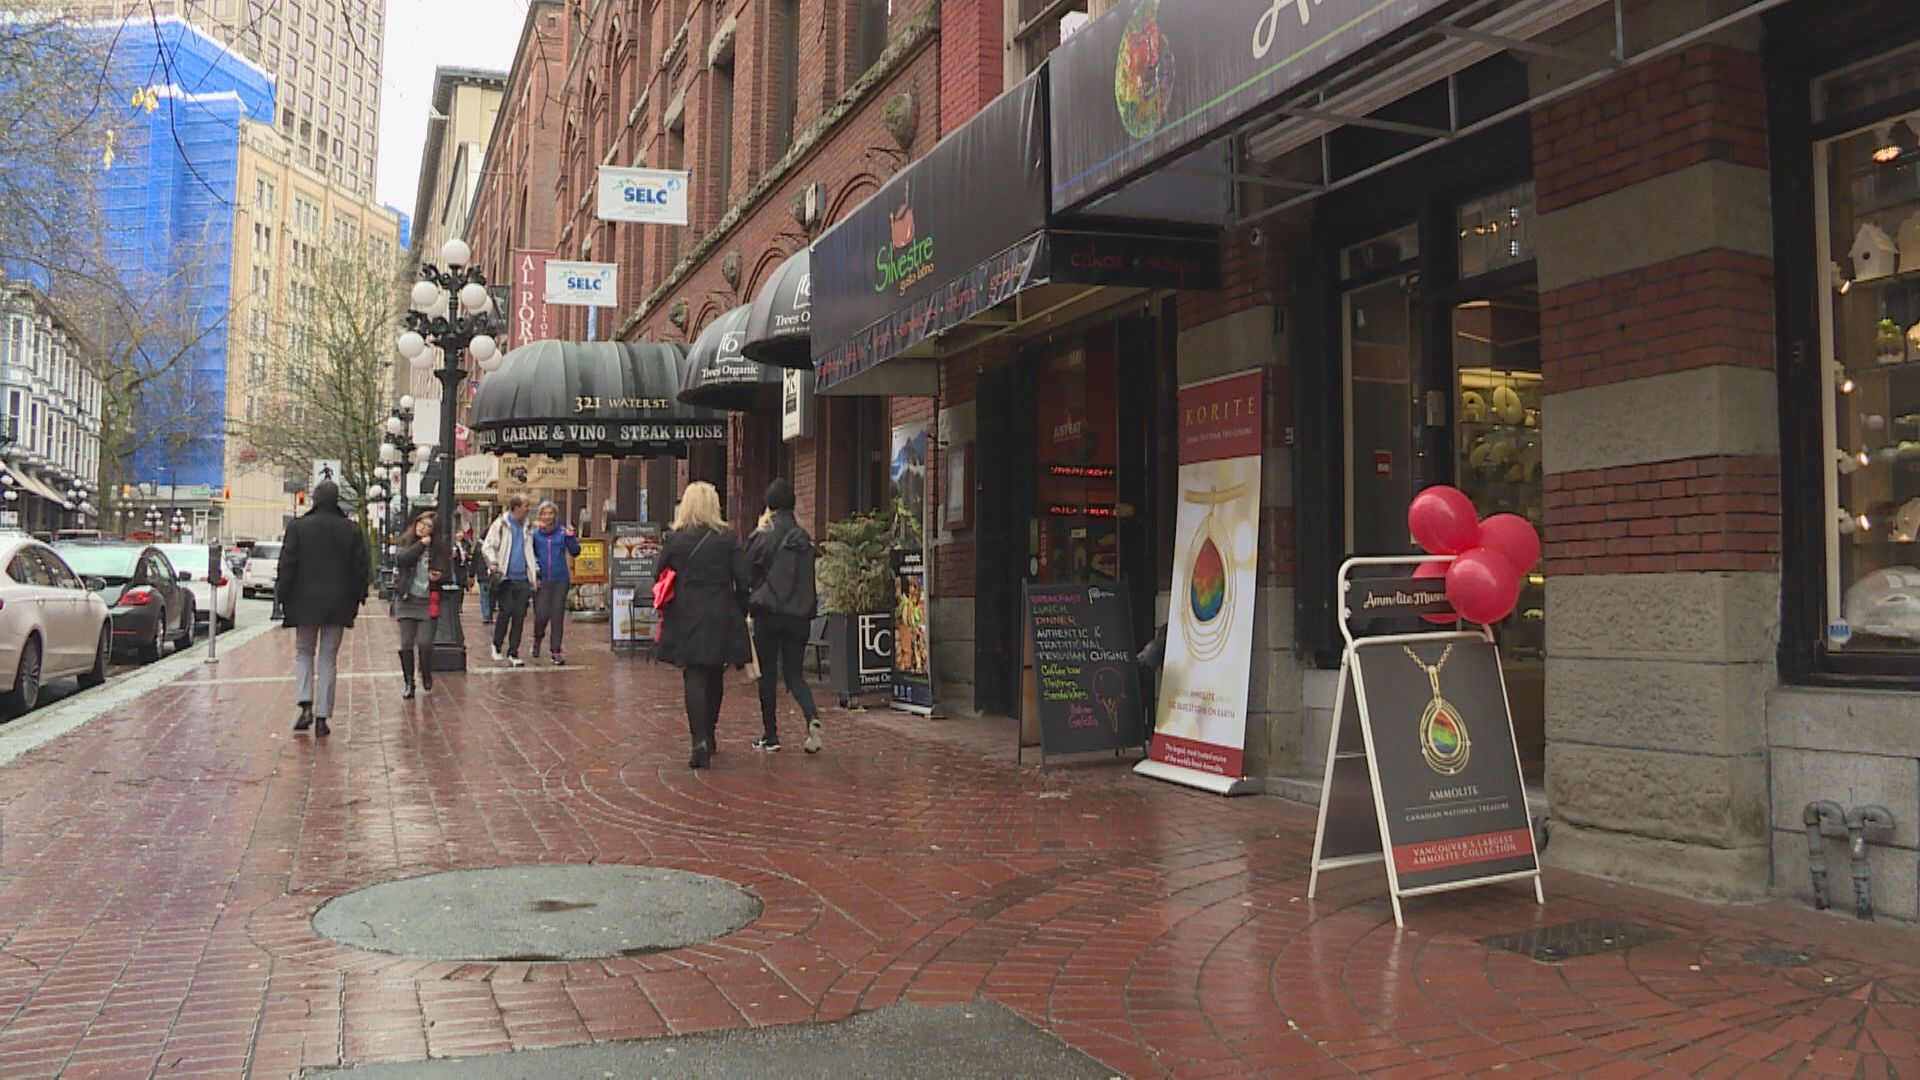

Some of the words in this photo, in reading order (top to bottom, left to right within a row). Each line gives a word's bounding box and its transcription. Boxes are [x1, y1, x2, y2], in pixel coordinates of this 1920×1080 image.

[624, 186, 668, 205] SELC
[874, 236, 934, 293] Silvestre
[567, 277, 602, 290] SELC
[774, 315, 799, 327] Trees
[701, 367, 722, 379] Trees
[721, 364, 759, 379] Organic
[574, 397, 601, 413] 321
[608, 398, 649, 409] WATER
[1185, 396, 1255, 427] KORITE
[502, 424, 549, 442] CARNE
[551, 427, 566, 441] &
[568, 424, 607, 441] VINO
[620, 424, 672, 441] STEAK
[672, 423, 724, 440] HOUSE
[537, 467, 569, 476] HOUSE
[1033, 604, 1067, 615] LUNCH
[1034, 616, 1078, 627] DINNER
[1036, 627, 1089, 639] AUTHENTIC
[1036, 640, 1103, 651] TRADITIONAL
[1036, 650, 1088, 662] PERUVIAN
[1089, 650, 1131, 663] CUISINE
[859, 674, 880, 684] Trees
[1429, 784, 1479, 801] AMMOLITE
[1405, 812, 1443, 823] CANADIAN
[1443, 806, 1477, 818] NATIONAL
[1479, 802, 1510, 813] TREASURE
[1412, 840, 1475, 857] VANCOUVER'S
[1476, 835, 1514, 848] LARGEST
[1412, 852, 1460, 866] AMMOLITE
[1461, 843, 1517, 858] COLLECTION
